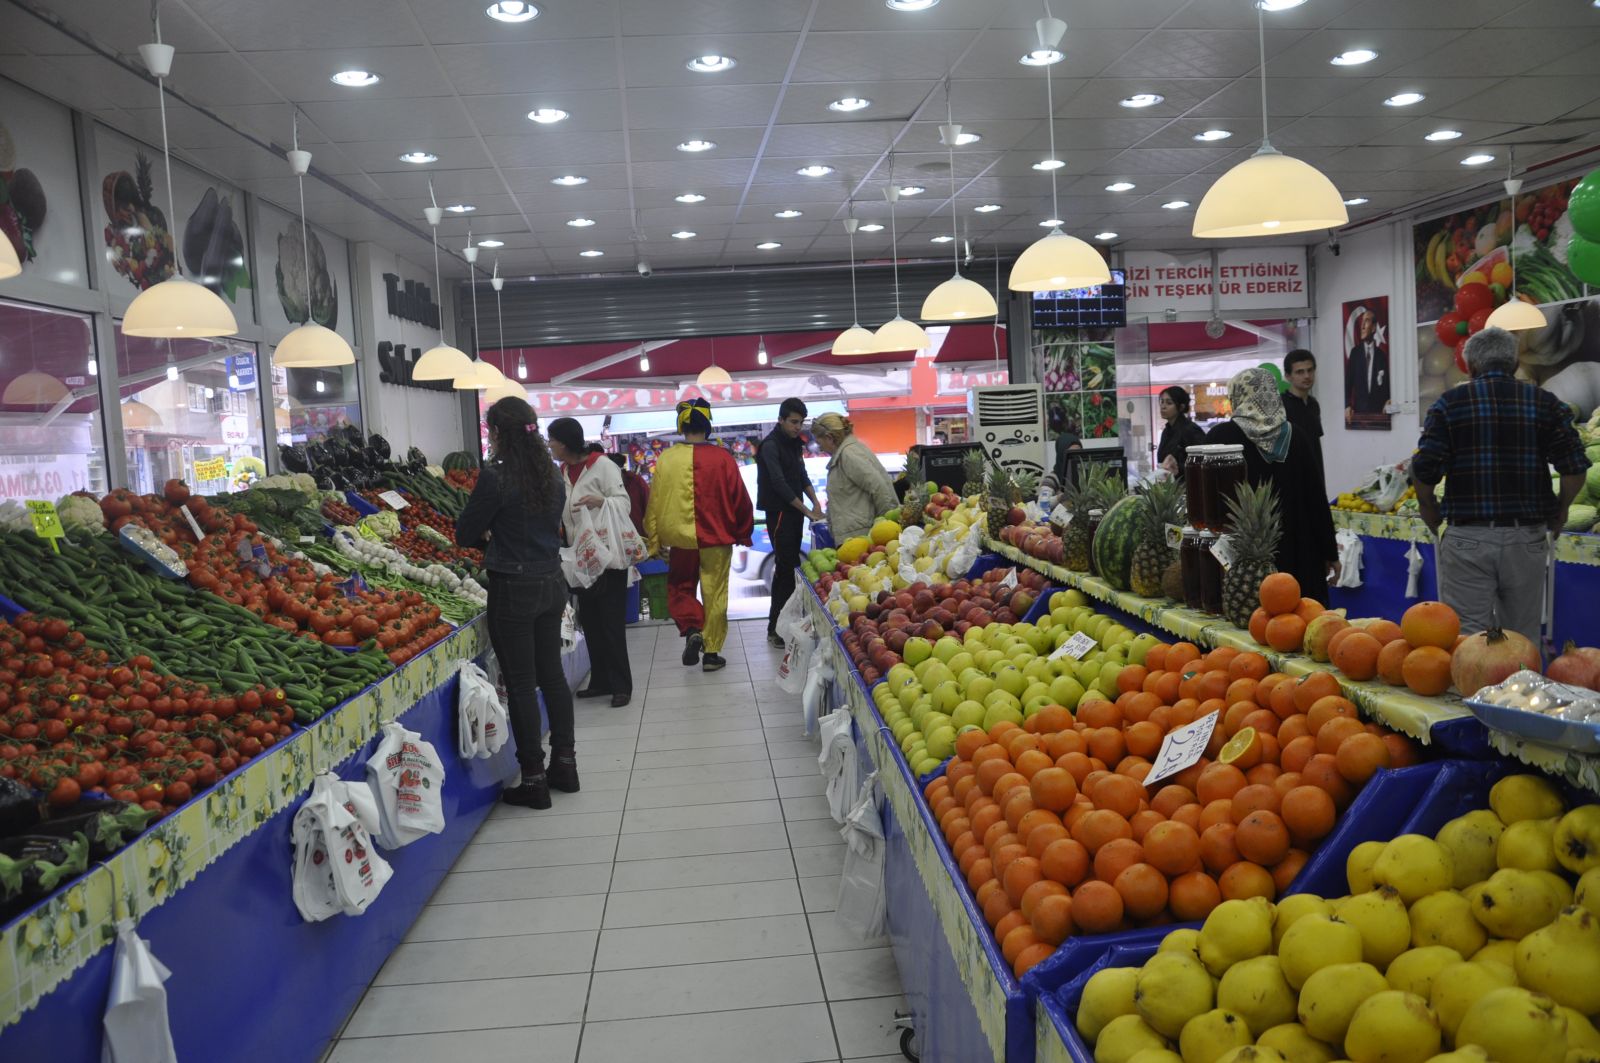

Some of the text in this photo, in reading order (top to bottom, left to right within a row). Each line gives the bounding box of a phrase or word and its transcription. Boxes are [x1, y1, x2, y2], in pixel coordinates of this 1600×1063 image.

[1155, 264, 1213, 279] TERCİH
[1220, 262, 1299, 278] ETTİĞİNİZ
[1246, 279, 1302, 294] EDERİZ
